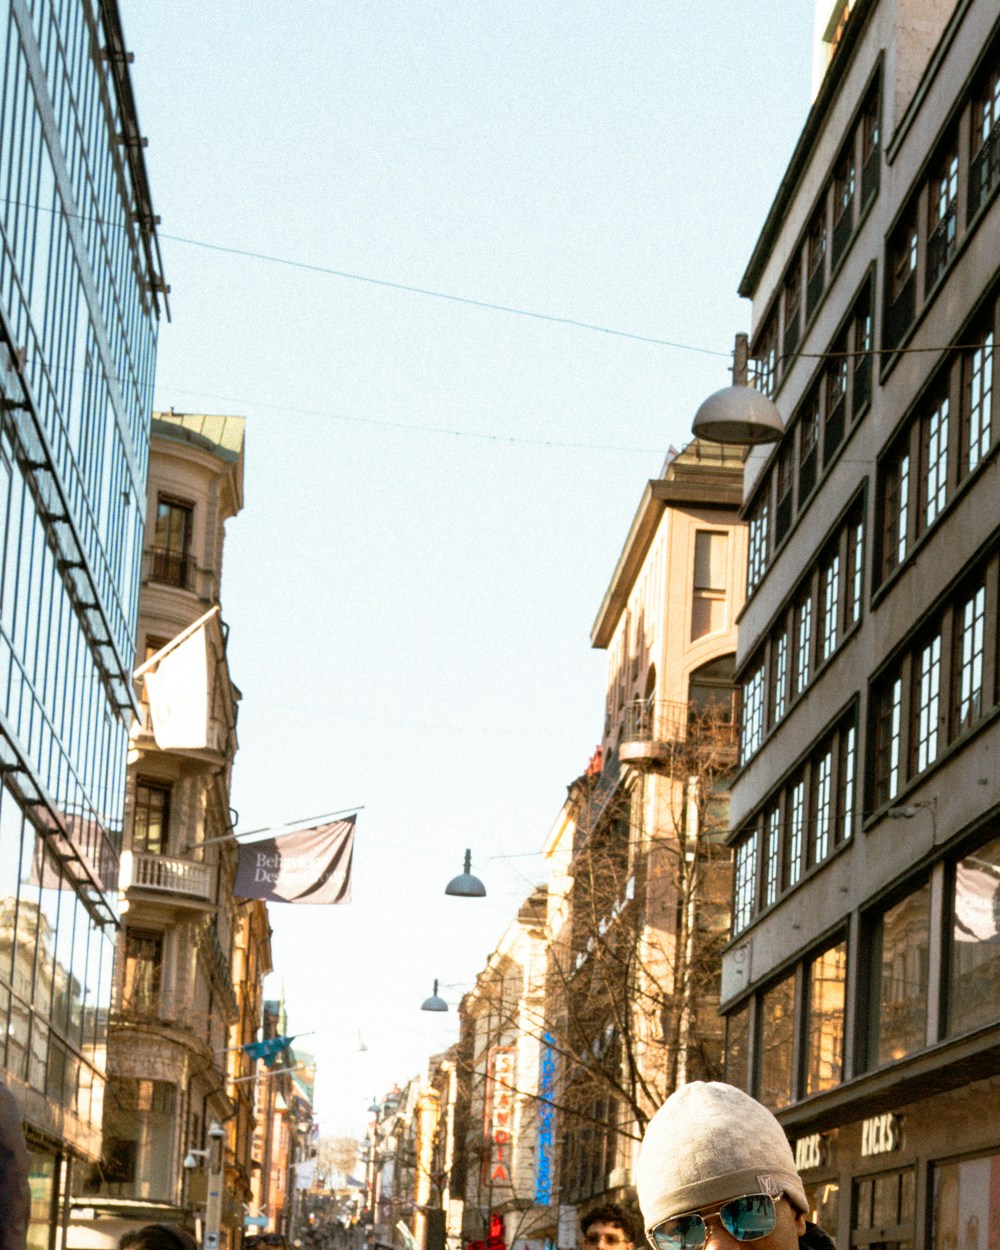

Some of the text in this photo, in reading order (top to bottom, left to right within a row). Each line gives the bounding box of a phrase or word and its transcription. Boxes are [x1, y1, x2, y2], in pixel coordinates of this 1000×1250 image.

[492, 1056, 510, 1181] SKANDIA
[861, 1113, 893, 1157] KICKS
[796, 1133, 821, 1171] KICKS
